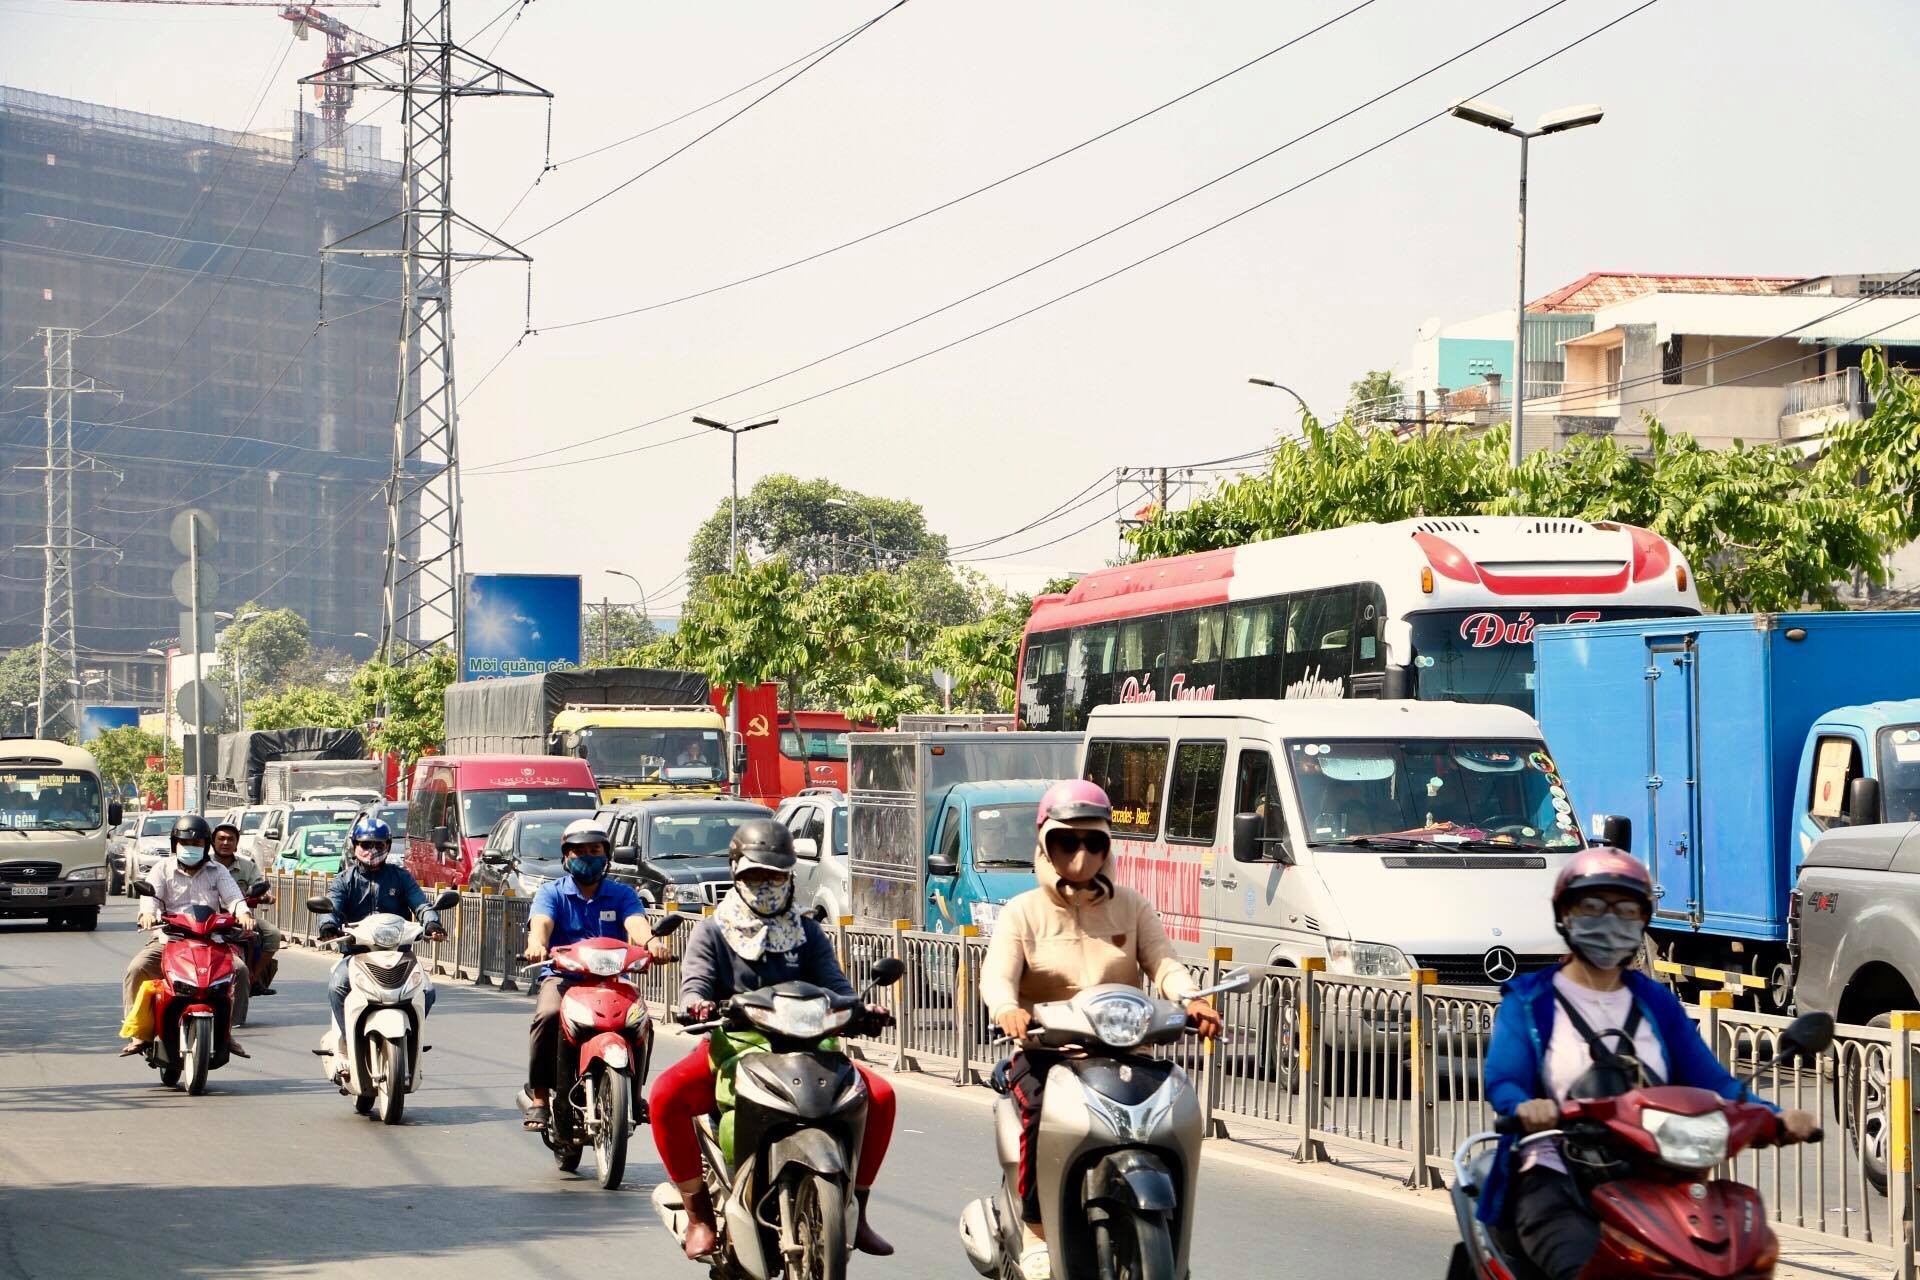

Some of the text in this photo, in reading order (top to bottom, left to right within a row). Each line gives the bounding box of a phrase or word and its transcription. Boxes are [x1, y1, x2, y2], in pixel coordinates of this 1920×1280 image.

[1460, 611, 1535, 648] Đứ
[469, 657, 498, 672] Mời
[501, 657, 545, 675] quảng
[1111, 805, 1135, 824] ercedes-
